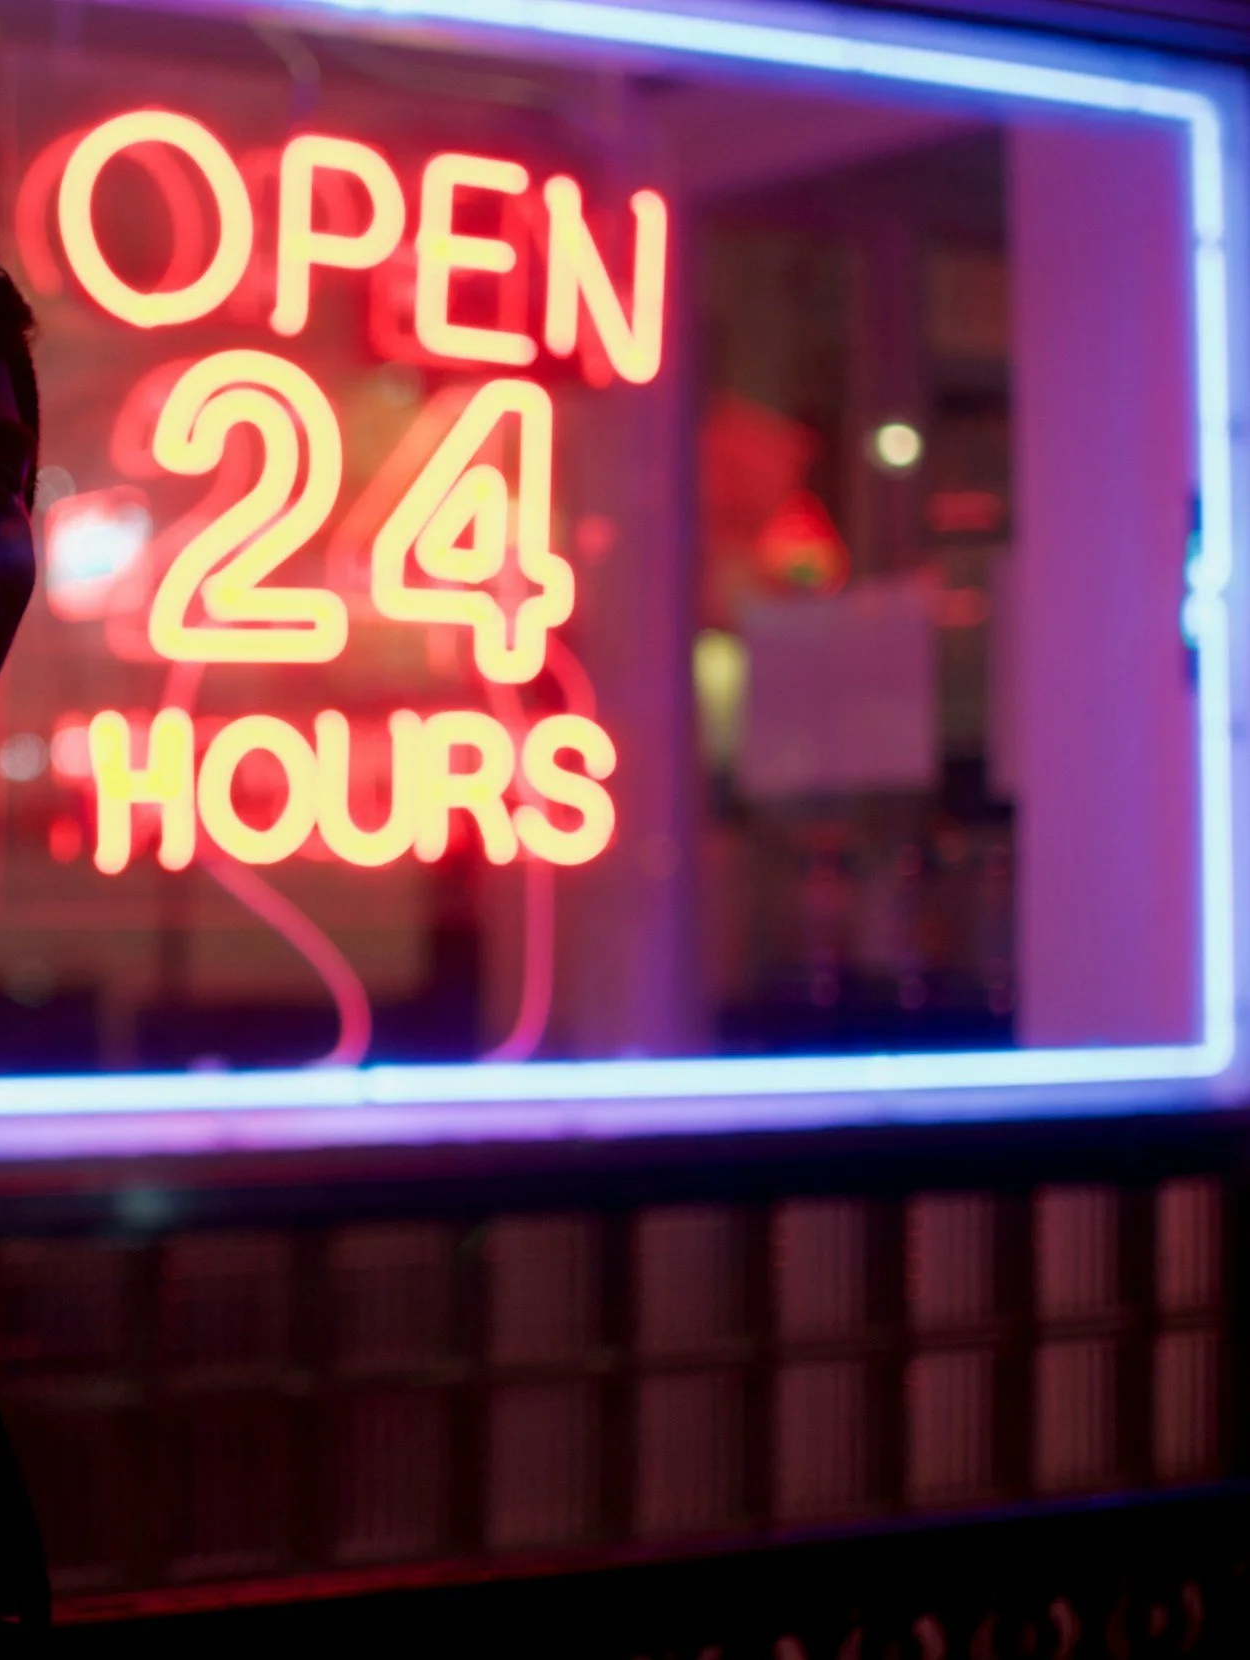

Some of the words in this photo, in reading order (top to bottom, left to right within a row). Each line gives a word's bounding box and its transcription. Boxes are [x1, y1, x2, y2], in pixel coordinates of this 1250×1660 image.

[59, 110, 667, 384] OPEN
[150, 349, 575, 684] 24
[89, 706, 617, 874] HOURS
